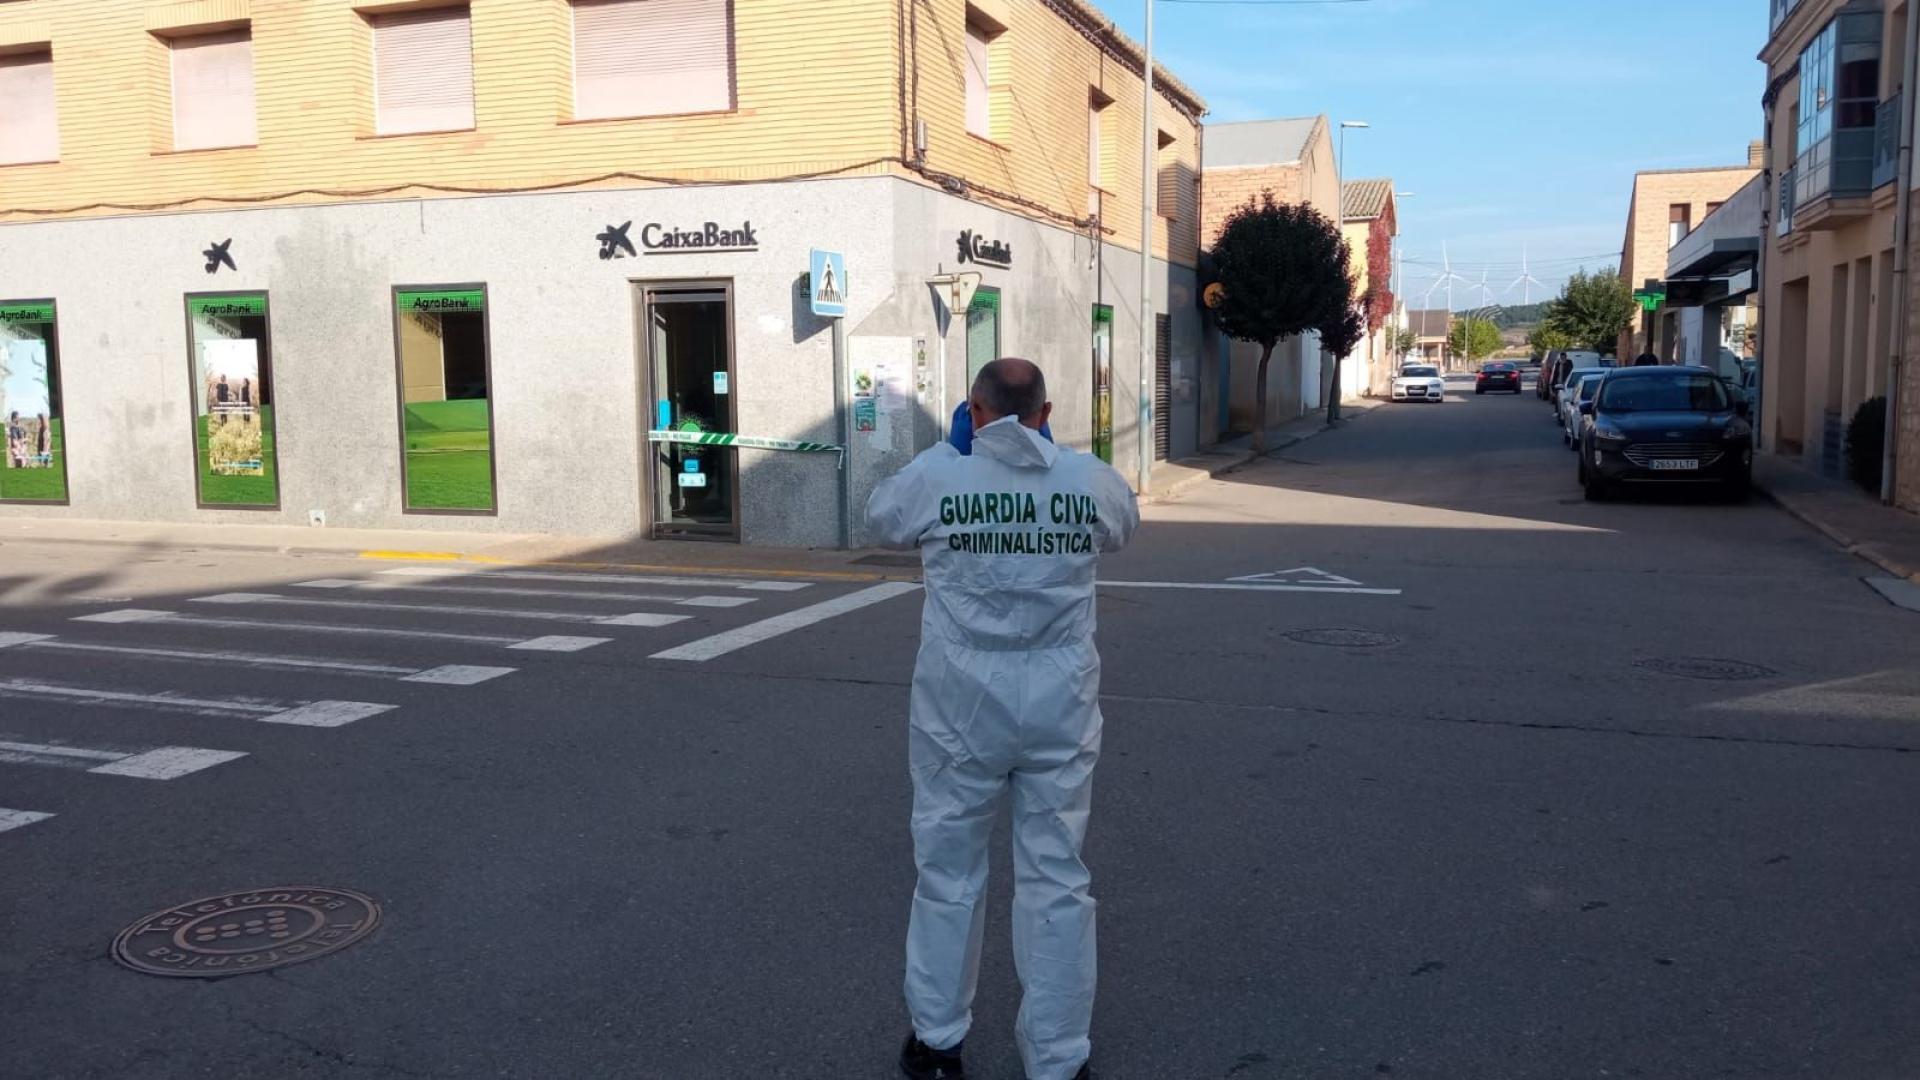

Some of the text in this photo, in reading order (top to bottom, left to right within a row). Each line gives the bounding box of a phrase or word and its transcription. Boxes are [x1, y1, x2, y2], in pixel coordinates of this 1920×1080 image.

[641, 220, 759, 249] CaixaBank
[0, 310, 42, 321] AgroBank
[202, 304, 251, 317] AgroBank
[412, 297, 470, 311] AgroBank
[940, 493, 1037, 525] GUARDIA
[949, 527, 1092, 554] CRIMINALÍSTICA
[136, 893, 346, 935] Telefónica
[148, 920, 363, 968] Telefónica
